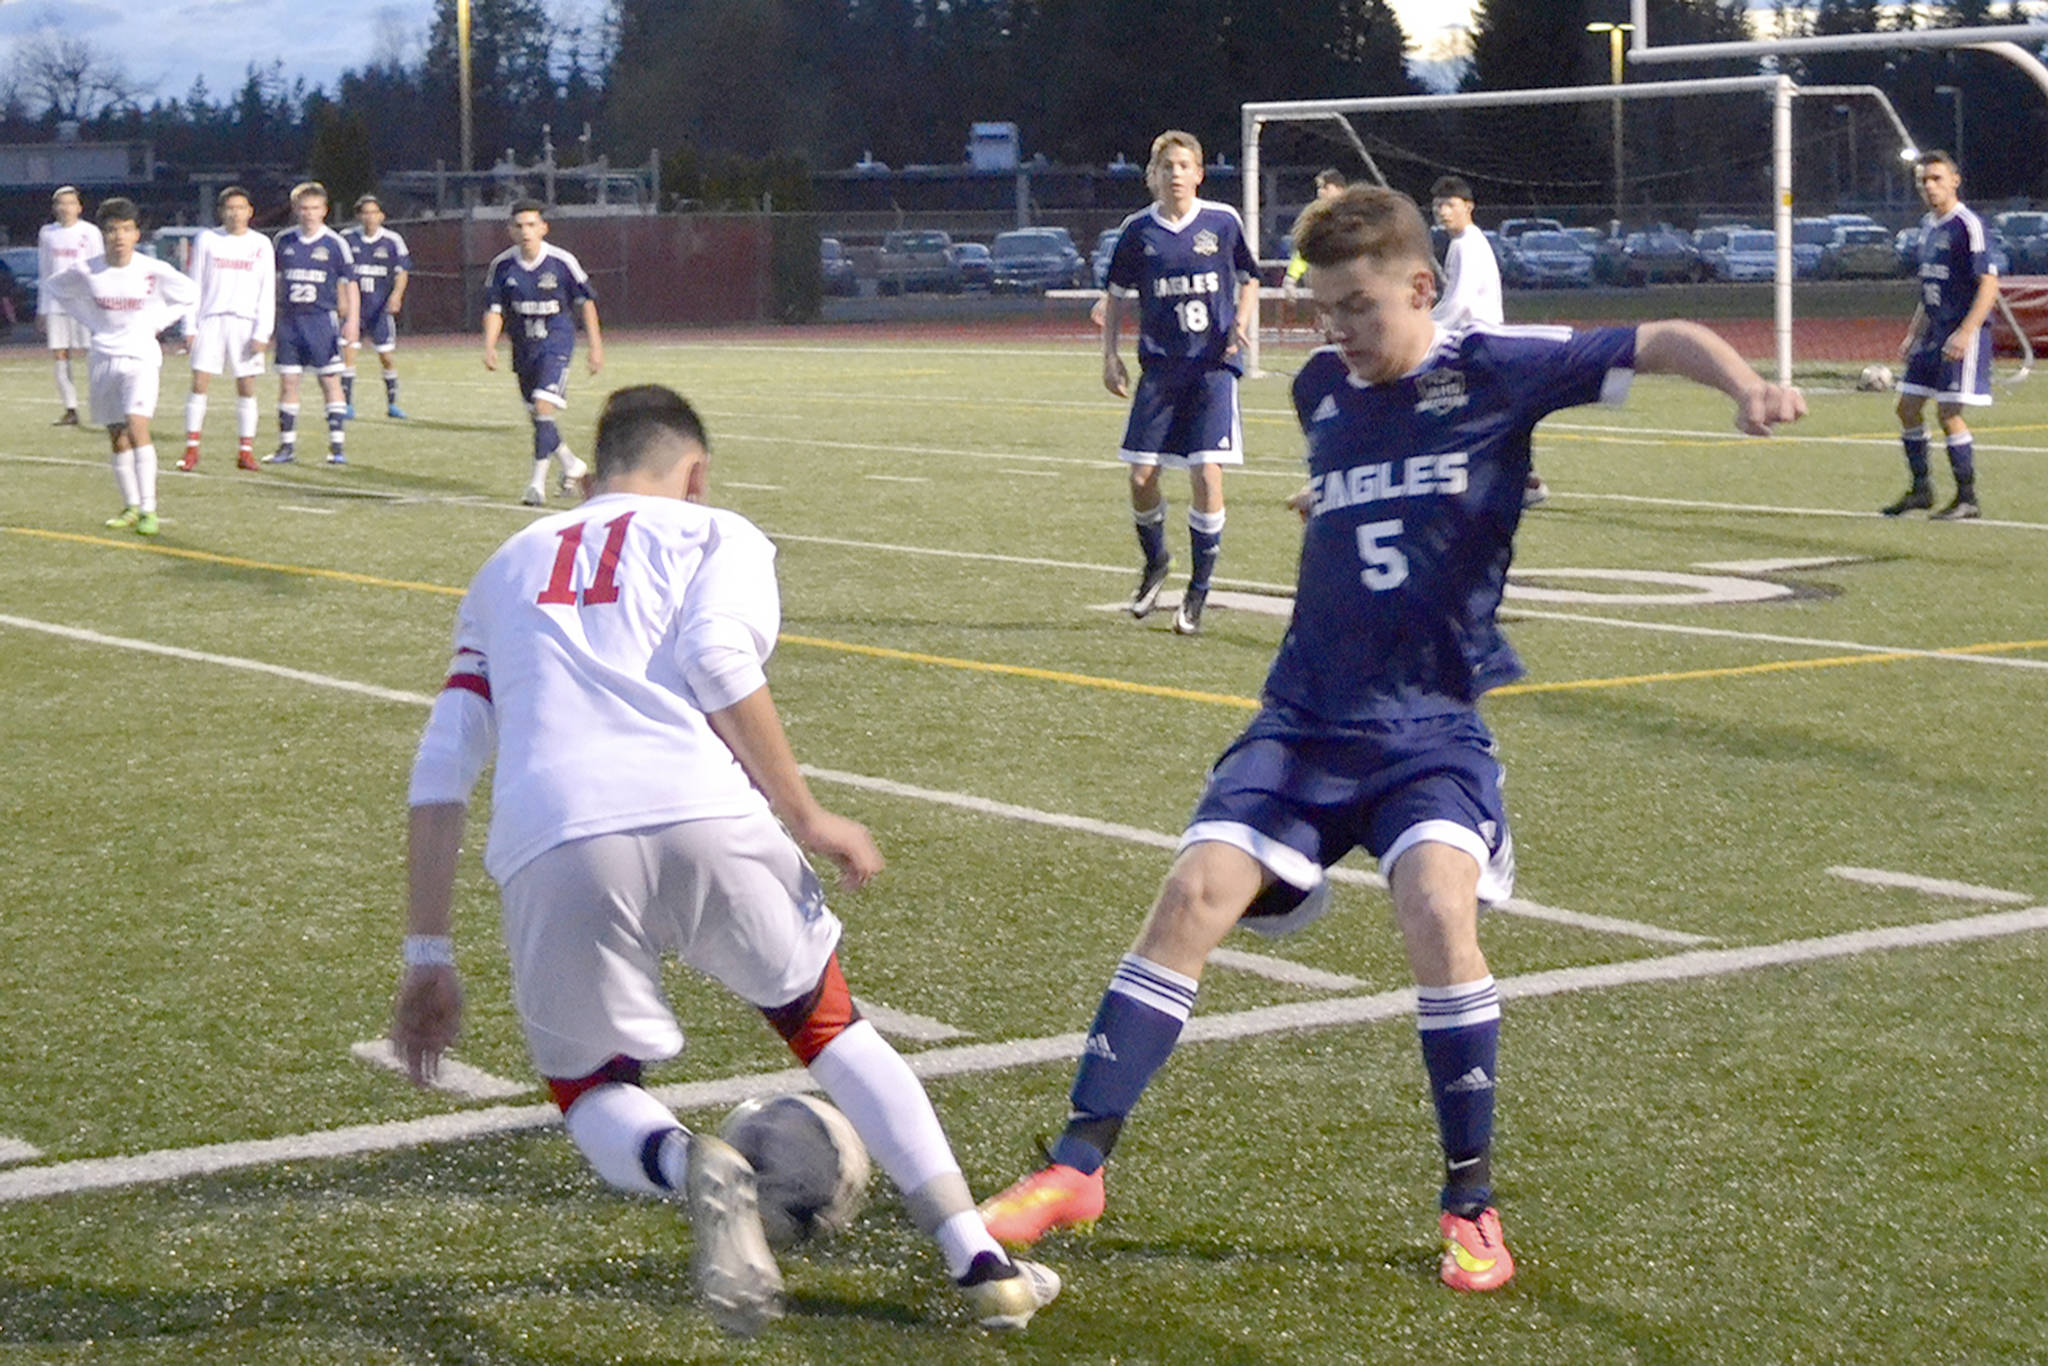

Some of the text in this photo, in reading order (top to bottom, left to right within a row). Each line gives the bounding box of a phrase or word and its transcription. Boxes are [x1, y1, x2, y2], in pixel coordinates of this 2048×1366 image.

[289, 283, 318, 303] 23
[1174, 300, 1209, 332] 18
[1310, 452, 1470, 516] EAGLES
[536, 510, 638, 606] 11
[1356, 518, 1410, 592] 5
